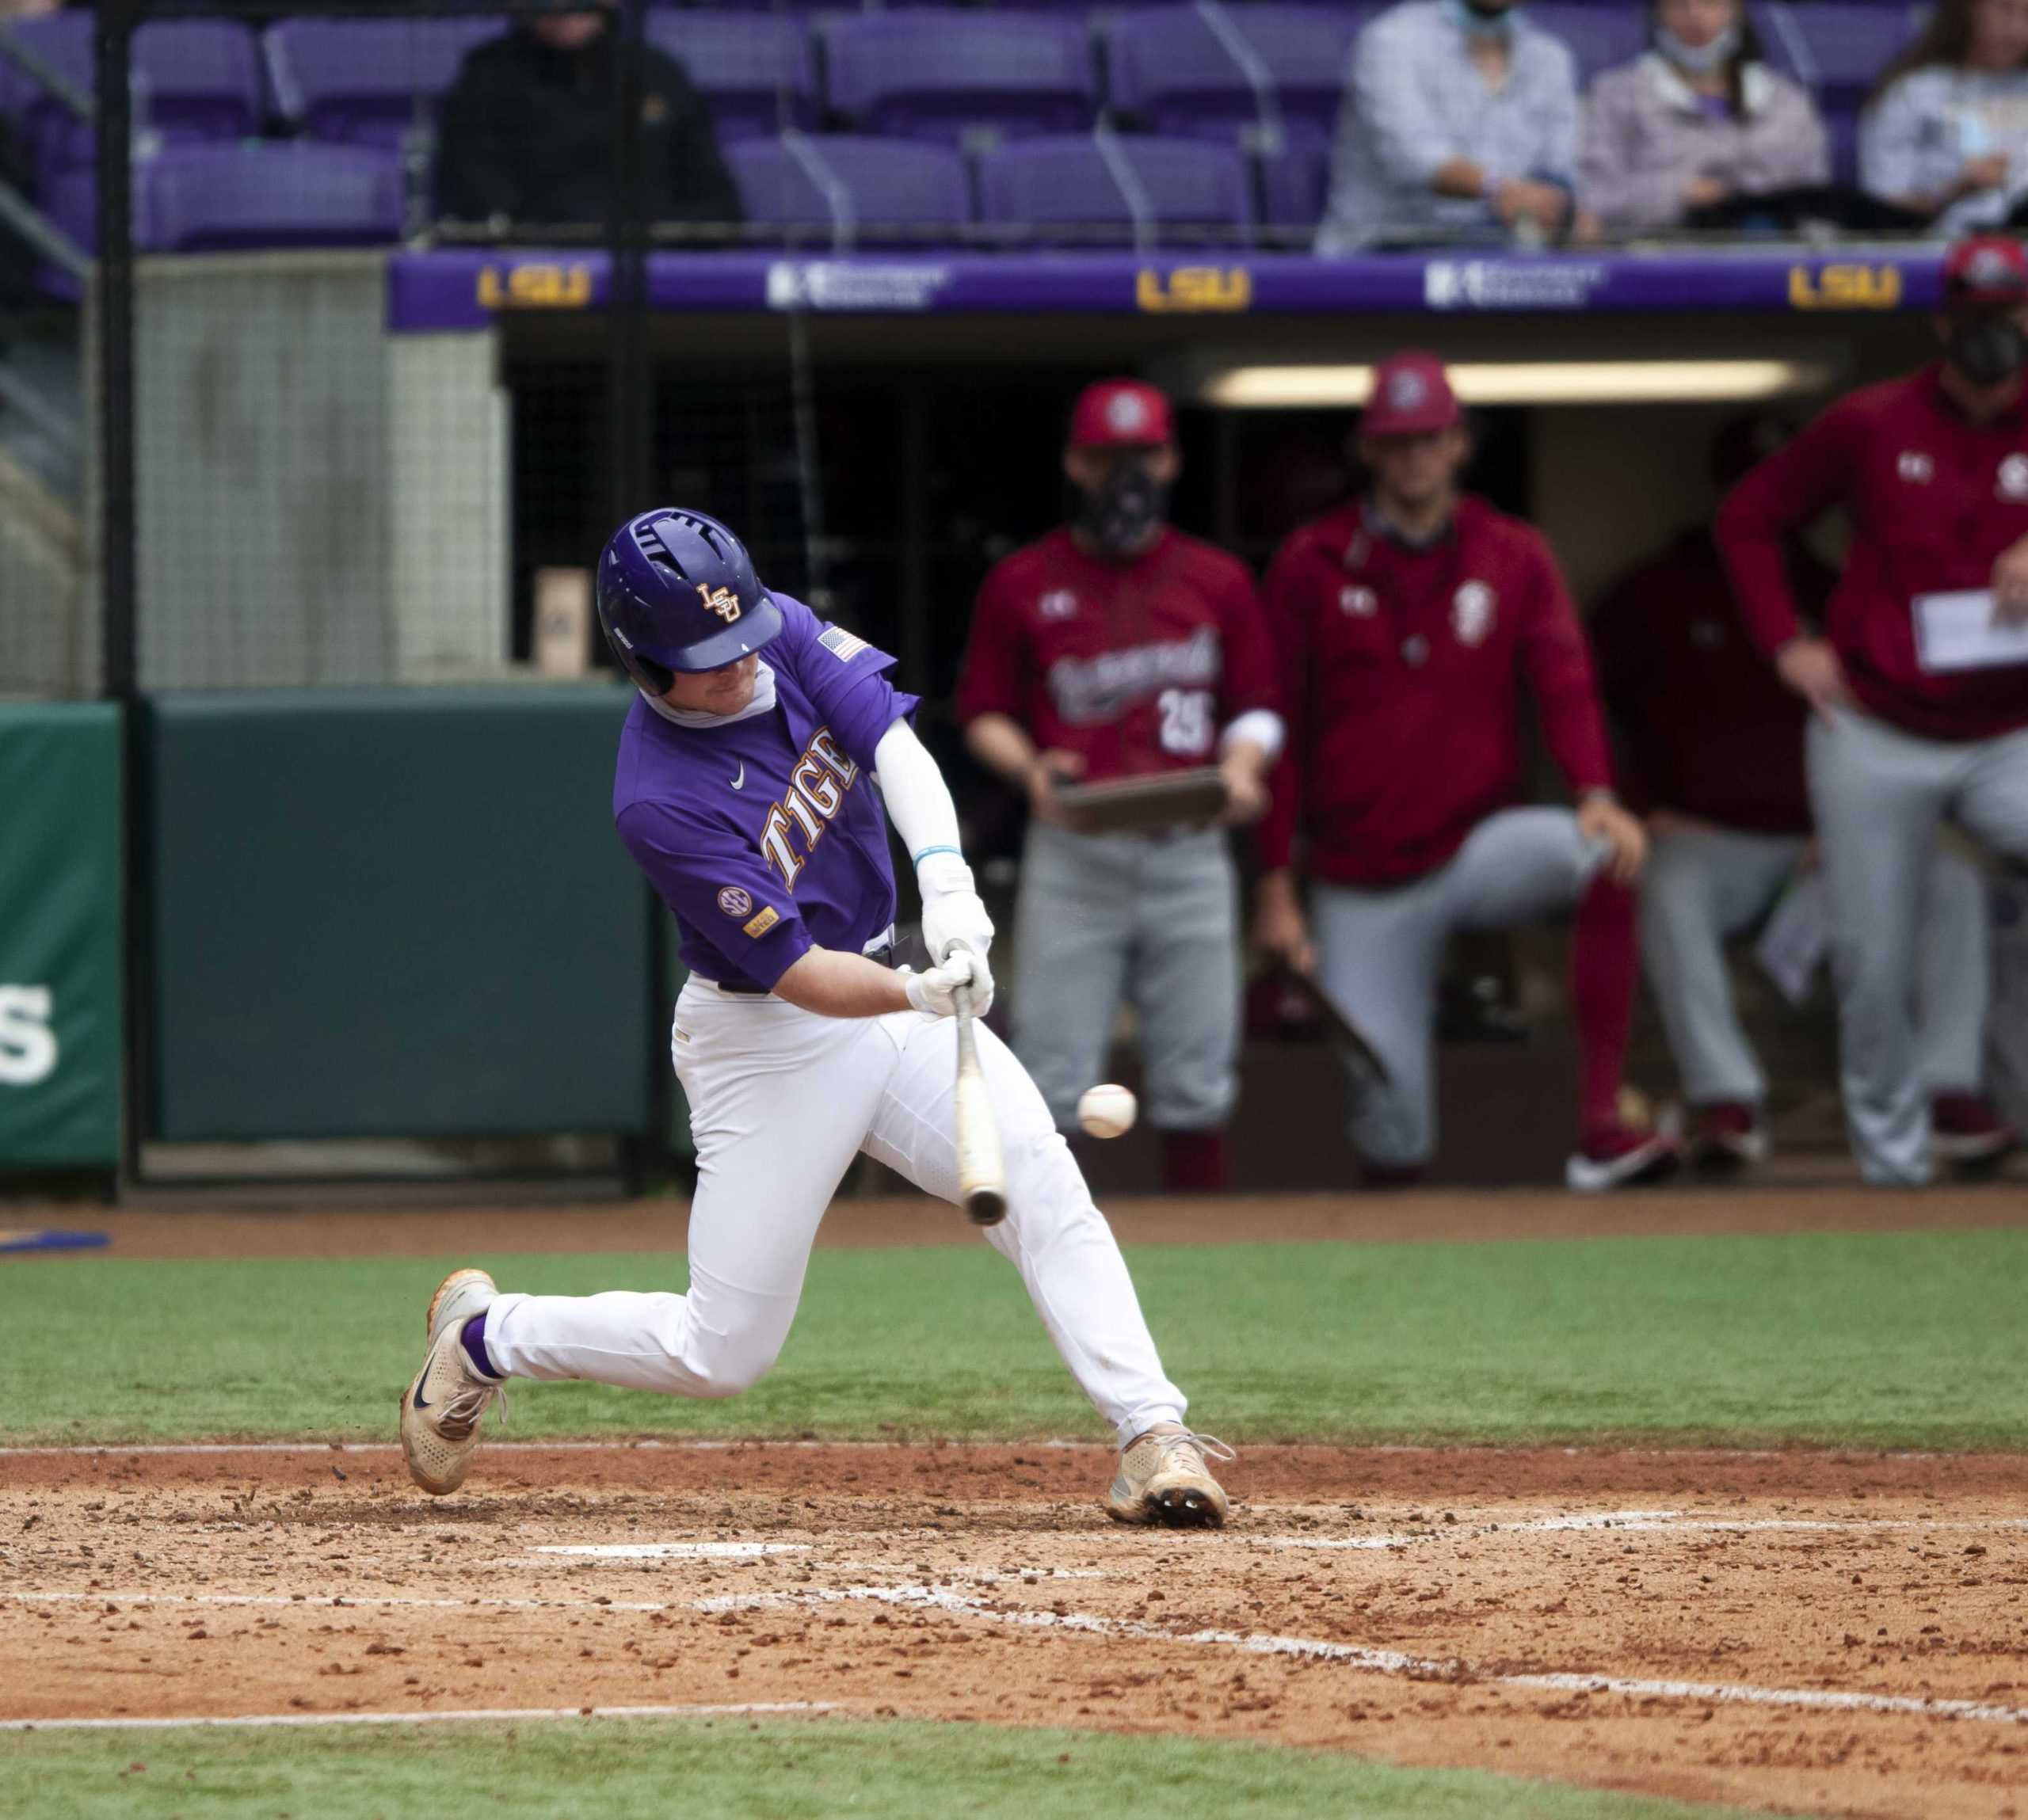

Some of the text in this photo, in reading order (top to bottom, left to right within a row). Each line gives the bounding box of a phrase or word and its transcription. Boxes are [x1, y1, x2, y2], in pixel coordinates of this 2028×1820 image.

[477, 265, 592, 307] LSU
[1136, 266, 1252, 313] LSU
[1787, 265, 1901, 310] LSU
[696, 583, 741, 624] LSU
